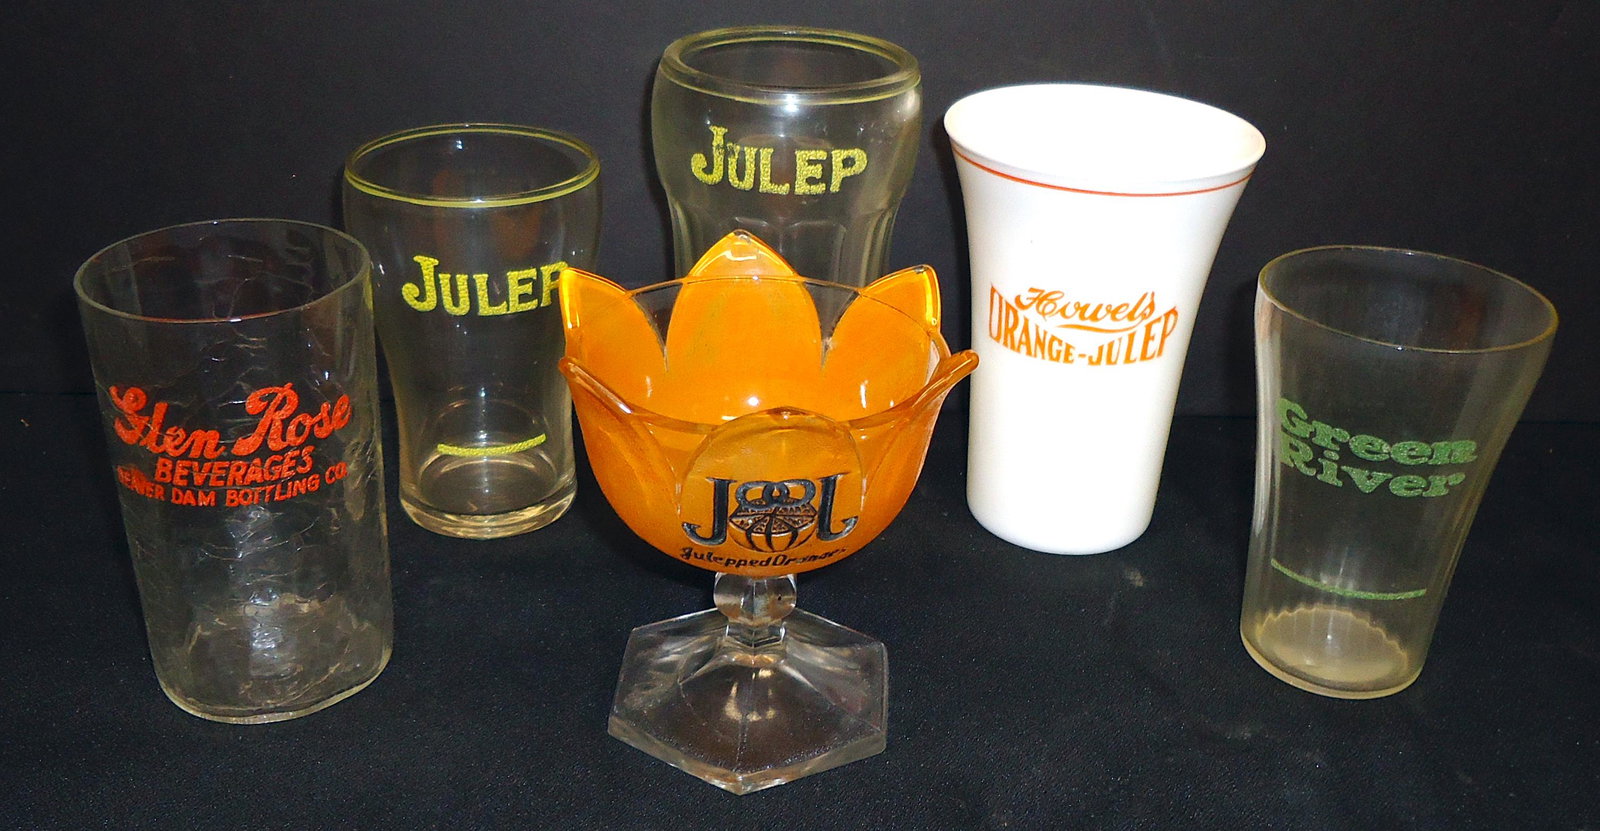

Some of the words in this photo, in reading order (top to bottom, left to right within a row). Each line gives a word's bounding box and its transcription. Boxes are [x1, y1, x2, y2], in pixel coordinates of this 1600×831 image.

[691, 125, 868, 195] JULEP
[401, 255, 568, 316] JULEP
[1014, 287, 1156, 324] Howel's
[989, 283, 1179, 366] ORANGE-JULEP
[109, 385, 226, 459] Glen
[231, 382, 352, 457] Rose
[1276, 397, 1478, 466] Green
[154, 445, 317, 487] BEVERAGES
[171, 487, 216, 507] DAM
[225, 474, 321, 507] BOTTLING
[1279, 434, 1467, 498] River
